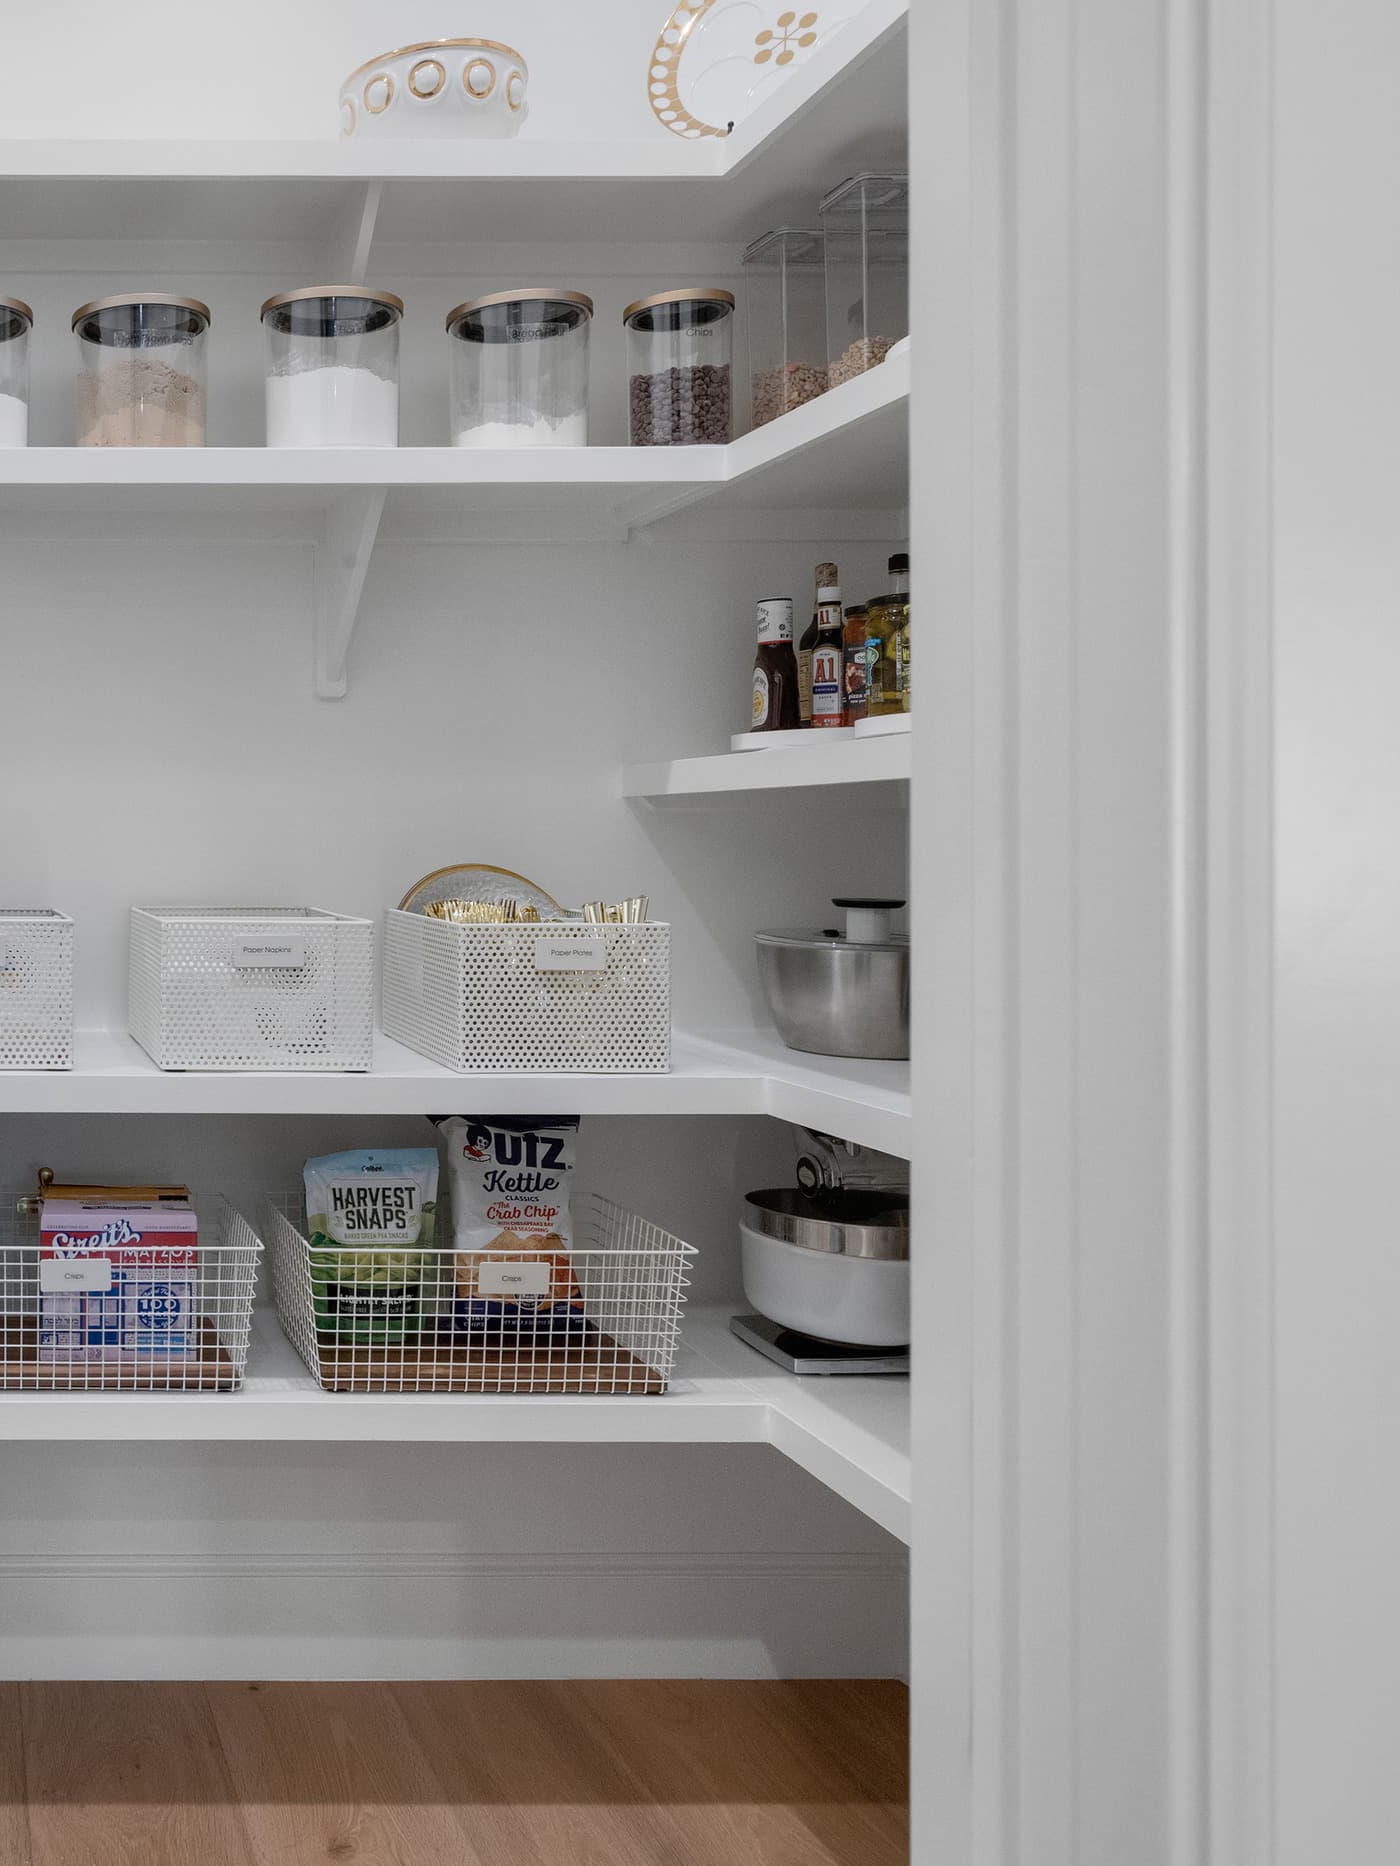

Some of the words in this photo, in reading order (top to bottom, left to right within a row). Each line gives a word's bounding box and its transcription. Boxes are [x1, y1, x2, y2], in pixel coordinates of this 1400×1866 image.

[685, 327, 714, 338] Chips
[242, 946, 264, 955] Paper
[265, 946, 292, 955] Napkins
[550, 949, 571, 958] Paper
[572, 949, 593, 957] Plates
[482, 1170, 560, 1193] Kettle
[332, 1186, 416, 1211] HARVEST
[345, 1208, 407, 1230] SNAPS
[486, 1206, 521, 1220] Crab
[140, 1299, 177, 1311] 100
[381, 1294, 414, 1306] SALTD
